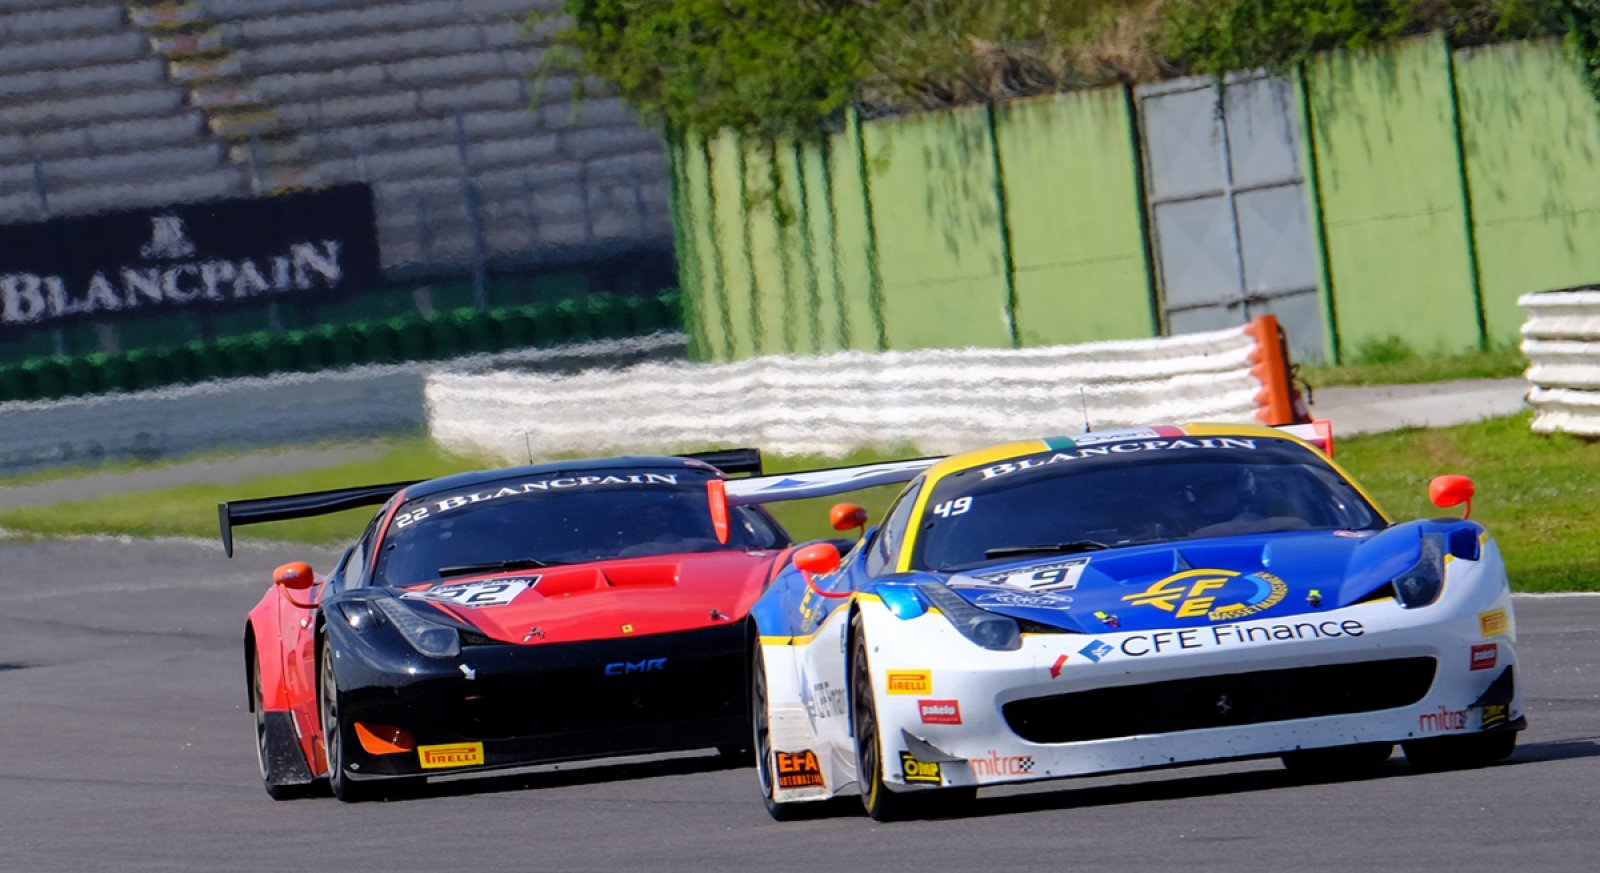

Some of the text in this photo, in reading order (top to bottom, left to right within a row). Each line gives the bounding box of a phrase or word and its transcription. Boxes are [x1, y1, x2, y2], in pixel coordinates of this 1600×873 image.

[0, 239, 342, 324] BLANCPAIN
[980, 438, 1257, 481] BLANCPAIN
[395, 473, 679, 529] 22 BLANCPAIN
[933, 496, 973, 518] 49
[1121, 618, 1365, 657] CFE Finance
[604, 657, 668, 676] CMR
[888, 674, 926, 690] PIRELLI
[424, 747, 477, 764] PIRELLI
[778, 751, 818, 772] EFA
